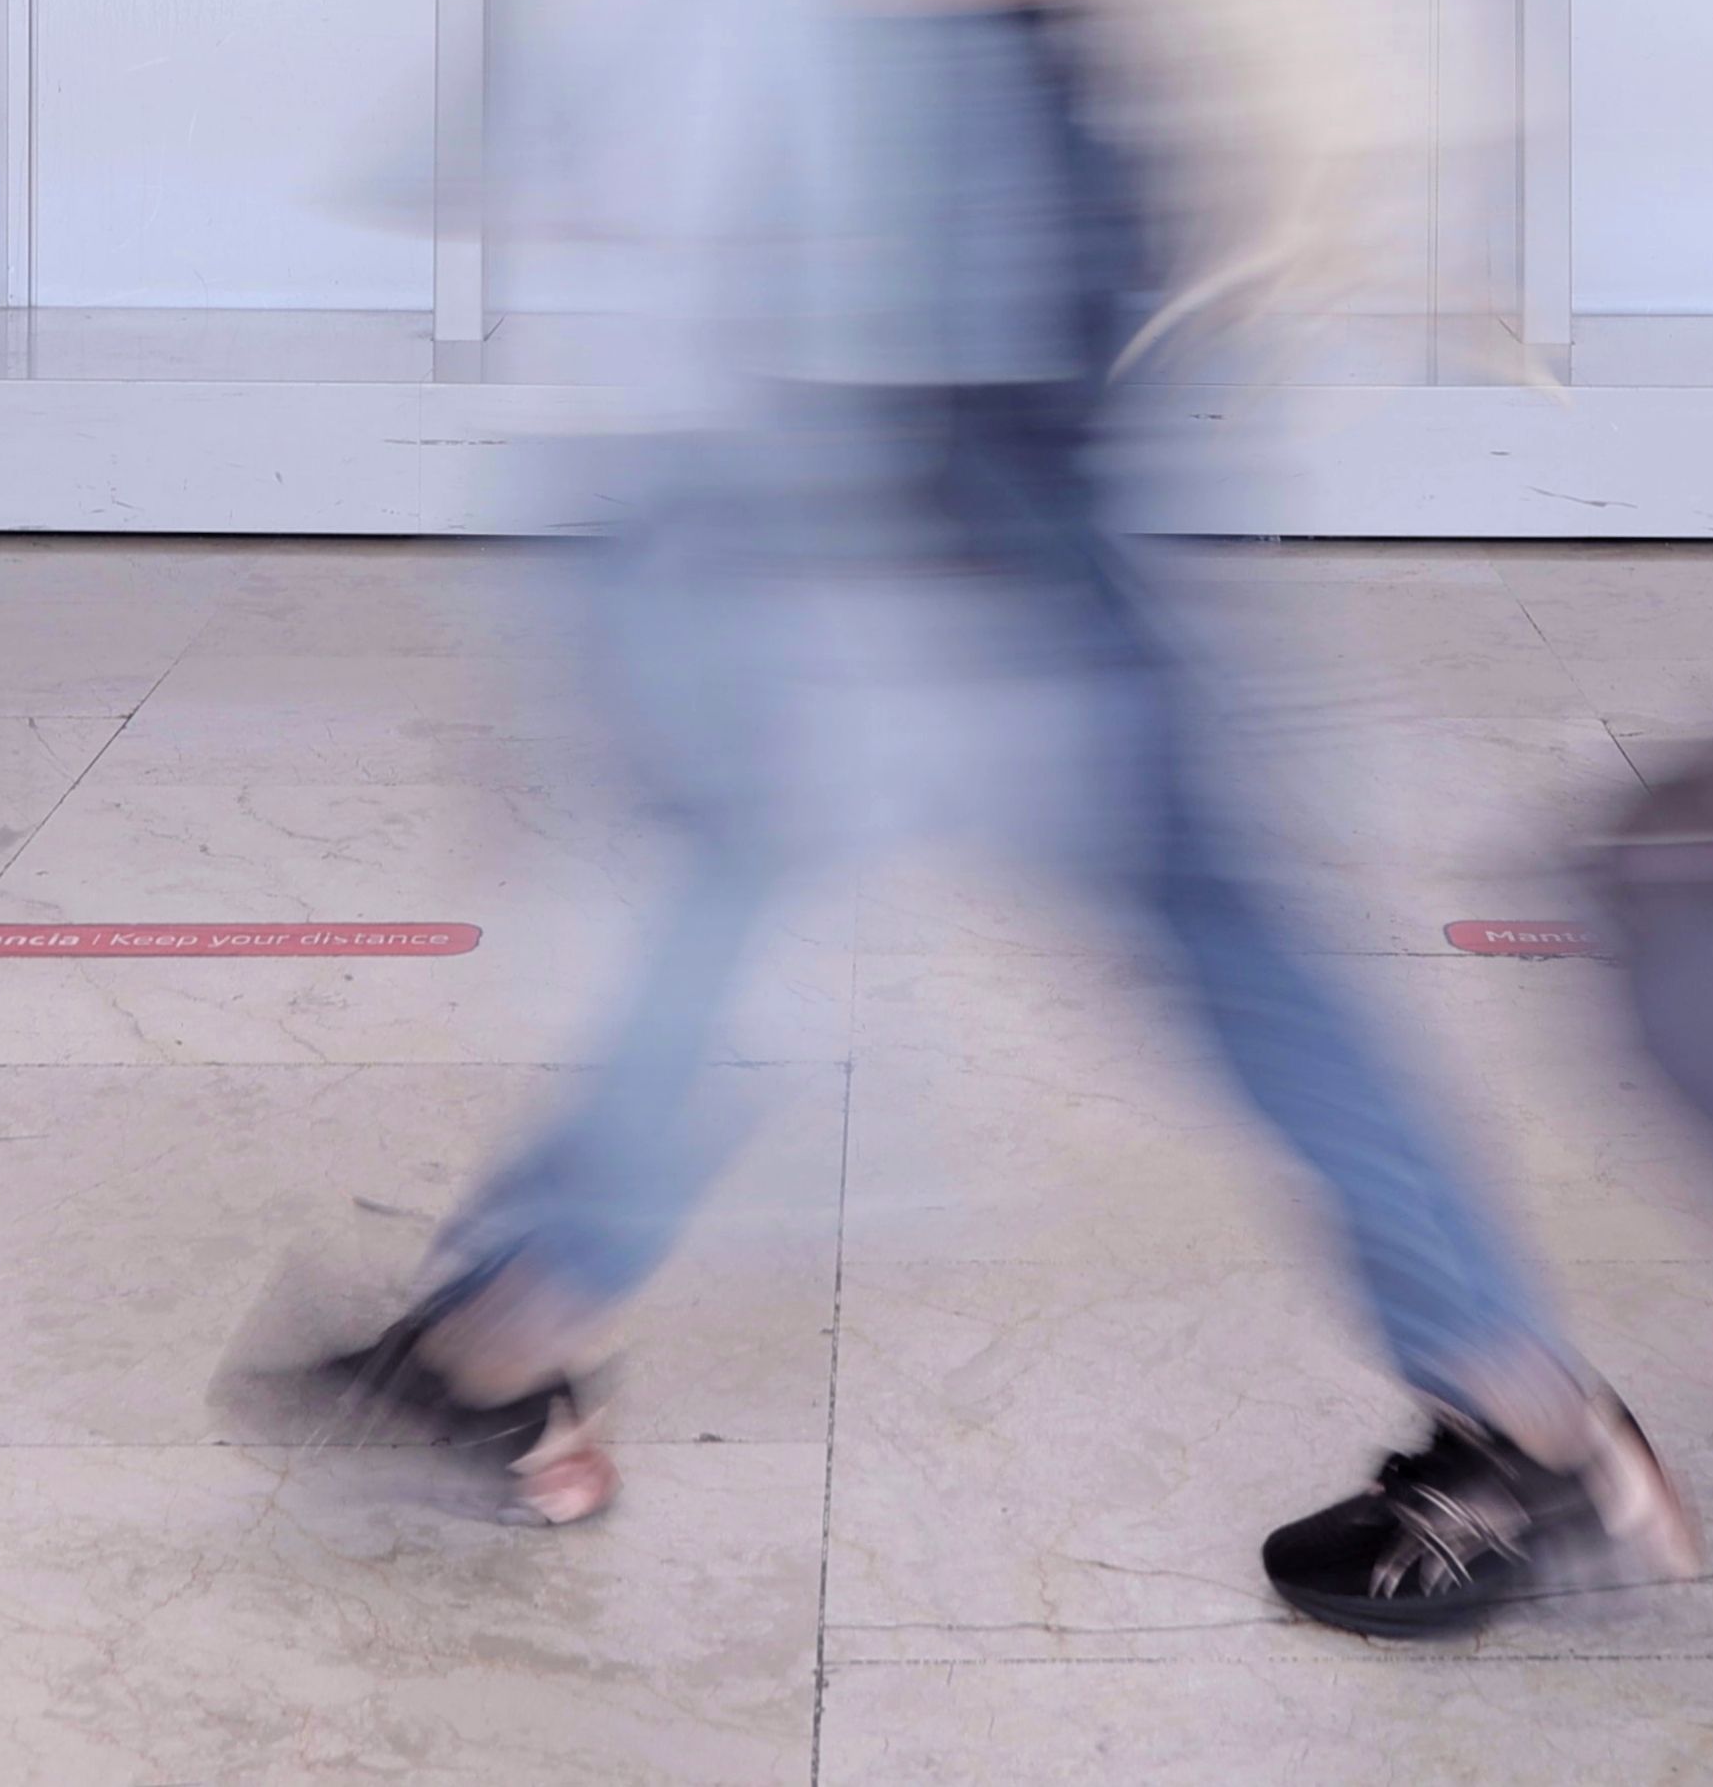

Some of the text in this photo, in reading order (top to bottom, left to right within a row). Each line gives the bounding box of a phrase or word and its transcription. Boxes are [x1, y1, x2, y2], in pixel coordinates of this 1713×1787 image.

[110, 932, 449, 948] Keep your distance
[1485, 930, 1599, 943] Mant
